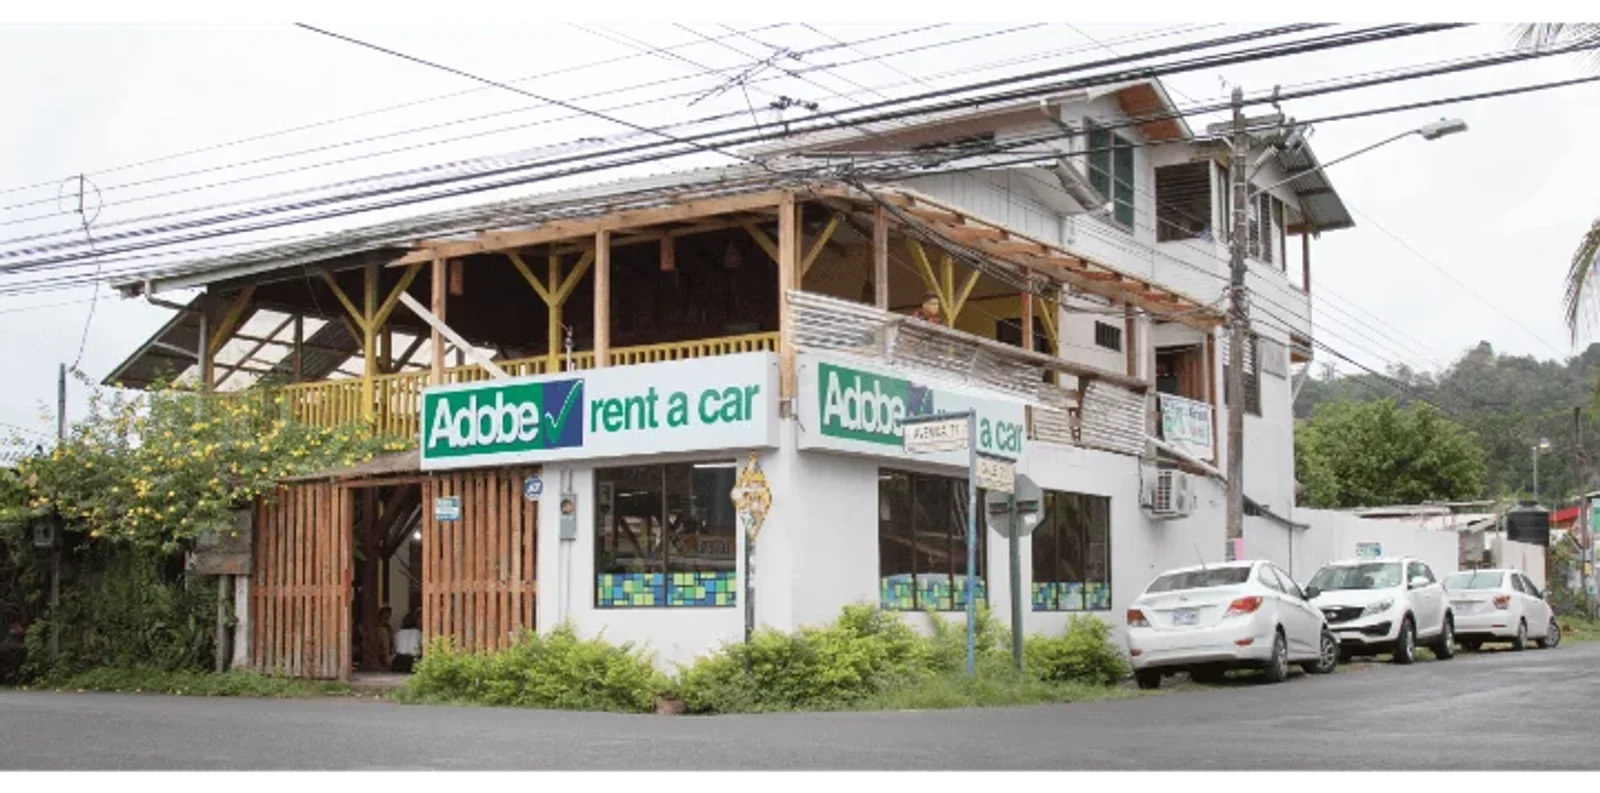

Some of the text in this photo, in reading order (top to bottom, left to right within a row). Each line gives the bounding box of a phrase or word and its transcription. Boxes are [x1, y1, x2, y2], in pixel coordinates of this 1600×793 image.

[428, 384, 760, 450] Adobe rent a car
[823, 370, 1023, 454] Adobe a car
